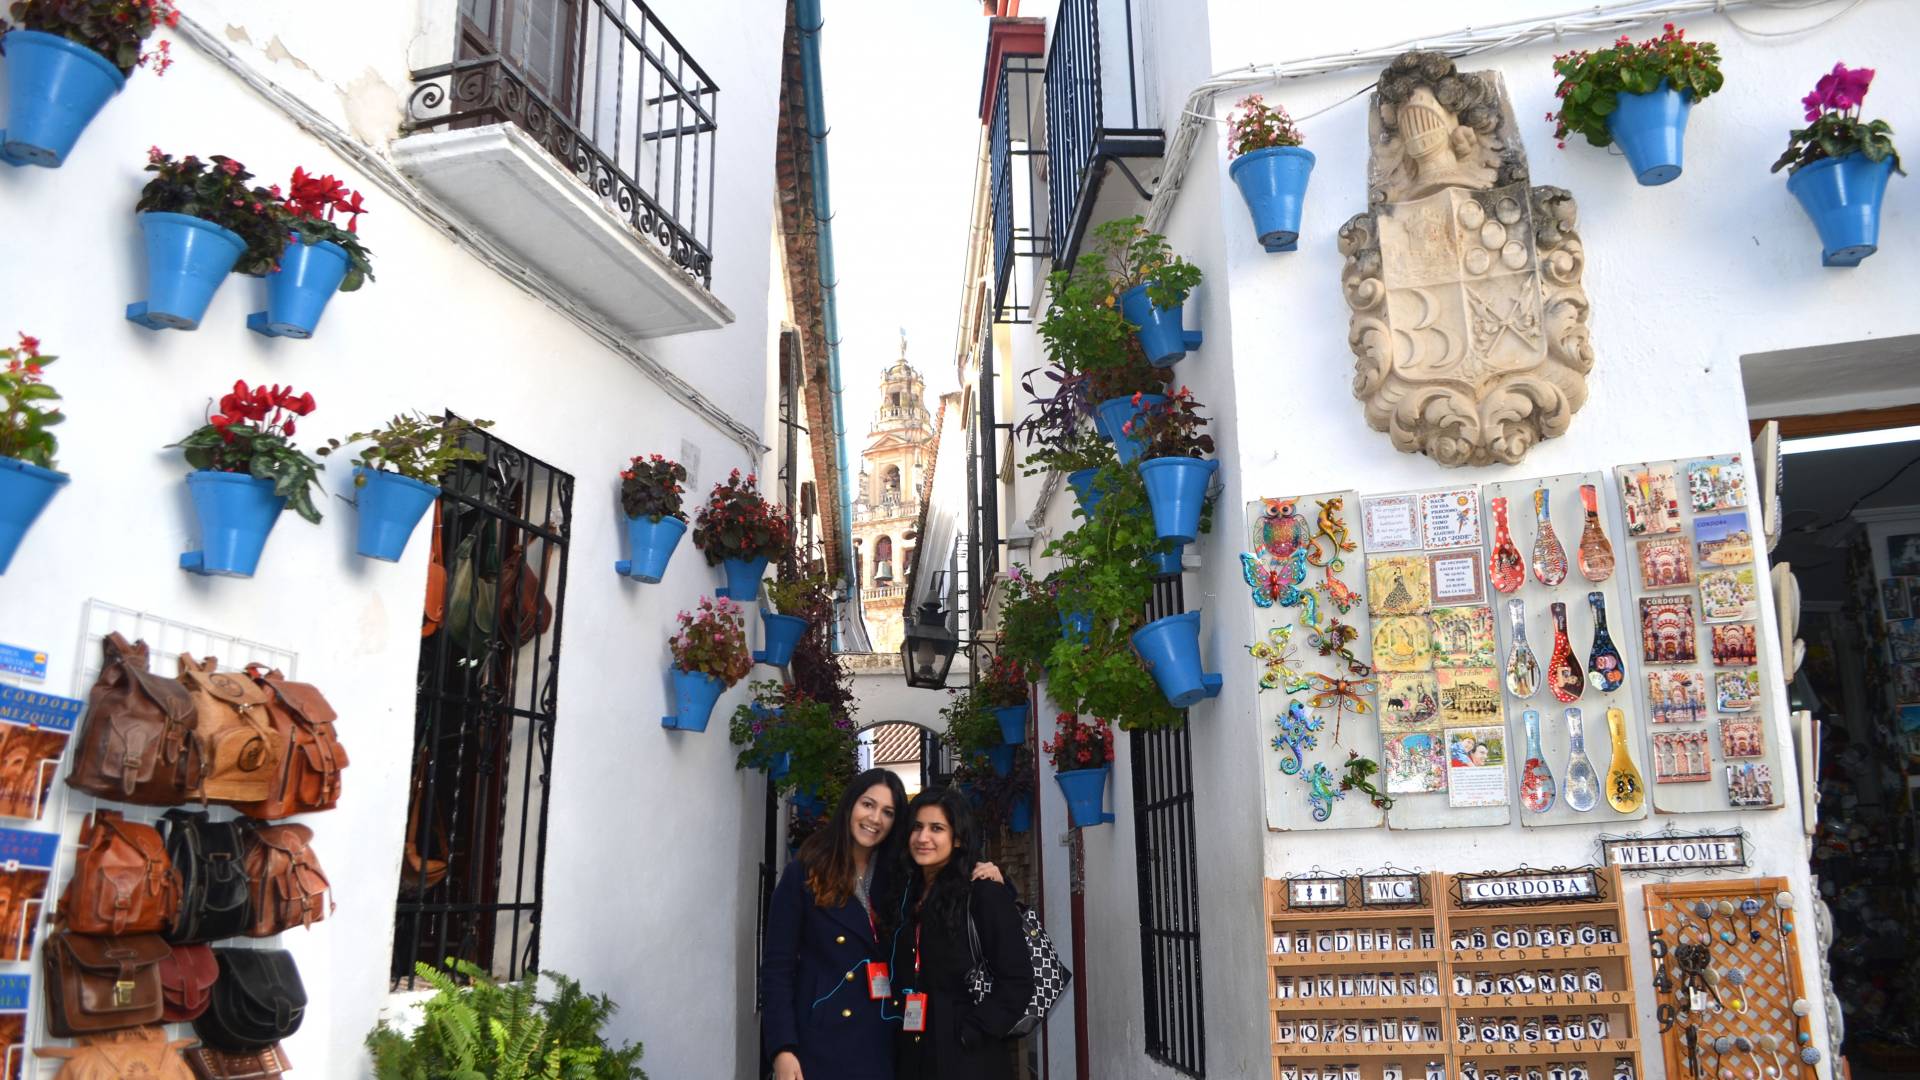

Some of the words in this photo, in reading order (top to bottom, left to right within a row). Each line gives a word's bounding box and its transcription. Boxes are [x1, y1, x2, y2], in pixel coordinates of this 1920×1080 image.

[1621, 843, 1728, 863] WELCOME
[1378, 881, 1406, 898] WC
[1477, 879, 1581, 898] CORDOBA
[1276, 939, 1286, 952] A
[1319, 937, 1331, 951] C
[1337, 936, 1348, 950] D
[1360, 935, 1372, 950] E
[1379, 936, 1389, 949] F
[1399, 939, 1411, 950] G
[1422, 935, 1434, 949] H
[1455, 940, 1465, 950] A
[1474, 934, 1485, 947] B
[1496, 933, 1508, 947] C
[1518, 933, 1529, 946] D
[1540, 932, 1552, 945] E
[1560, 931, 1571, 944] F
[1582, 929, 1594, 942] G
[1601, 931, 1612, 943] H
[1649, 929, 1667, 958] 5
[1454, 952, 1463, 961] A
[1476, 952, 1484, 961] B
[1499, 951, 1506, 960] C
[1519, 950, 1527, 959] D
[1542, 949, 1550, 958] E
[1563, 949, 1571, 958] F
[1584, 947, 1592, 957] G
[1608, 946, 1616, 956] H
[1457, 979, 1464, 993] I
[1482, 982, 1492, 993] J
[1501, 981, 1513, 993] K
[1520, 978, 1532, 991] L
[1540, 977, 1552, 990] M
[1564, 977, 1575, 990] N
[1589, 974, 1600, 990] Ñ
[1653, 963, 1673, 993] 4
[1284, 987, 1289, 998] I
[1303, 982, 1312, 996] J
[1320, 981, 1332, 996] K
[1342, 982, 1353, 996] L
[1363, 980, 1375, 995] M
[1381, 981, 1393, 995] N
[1403, 980, 1415, 995] Ñ
[1422, 978, 1434, 994] O
[1462, 998, 1469, 1007] I
[1483, 997, 1489, 1006] J
[1504, 997, 1513, 1006] K
[1525, 997, 1534, 1006] L
[1546, 996, 1554, 1005] M
[1567, 995, 1575, 1004] N
[1612, 993, 1621, 1003] O
[1656, 1003, 1675, 1034] 9
[1281, 1027, 1292, 1039] P
[1304, 1025, 1317, 1042] Q
[1324, 1030, 1334, 1042] R
[1345, 1026, 1357, 1041] S
[1364, 1027, 1377, 1041] T
[1383, 1025, 1396, 1040] U
[1404, 1026, 1416, 1040] V
[1425, 1027, 1438, 1041] W
[1459, 1026, 1470, 1041] P
[1483, 1028, 1495, 1041] Q
[1504, 1026, 1517, 1039] R
[1526, 1030, 1538, 1040] S
[1549, 1029, 1560, 1040] T
[1570, 1027, 1582, 1038] U
[1590, 1022, 1603, 1036] V
[1464, 1045, 1471, 1054] P
[1485, 1045, 1494, 1054] Q
[1508, 1044, 1518, 1054] R
[1530, 1043, 1538, 1053] S
[1551, 1042, 1560, 1052] T
[1574, 1042, 1582, 1051] U
[1594, 1041, 1602, 1051] V
[1616, 1040, 1627, 1050] W
